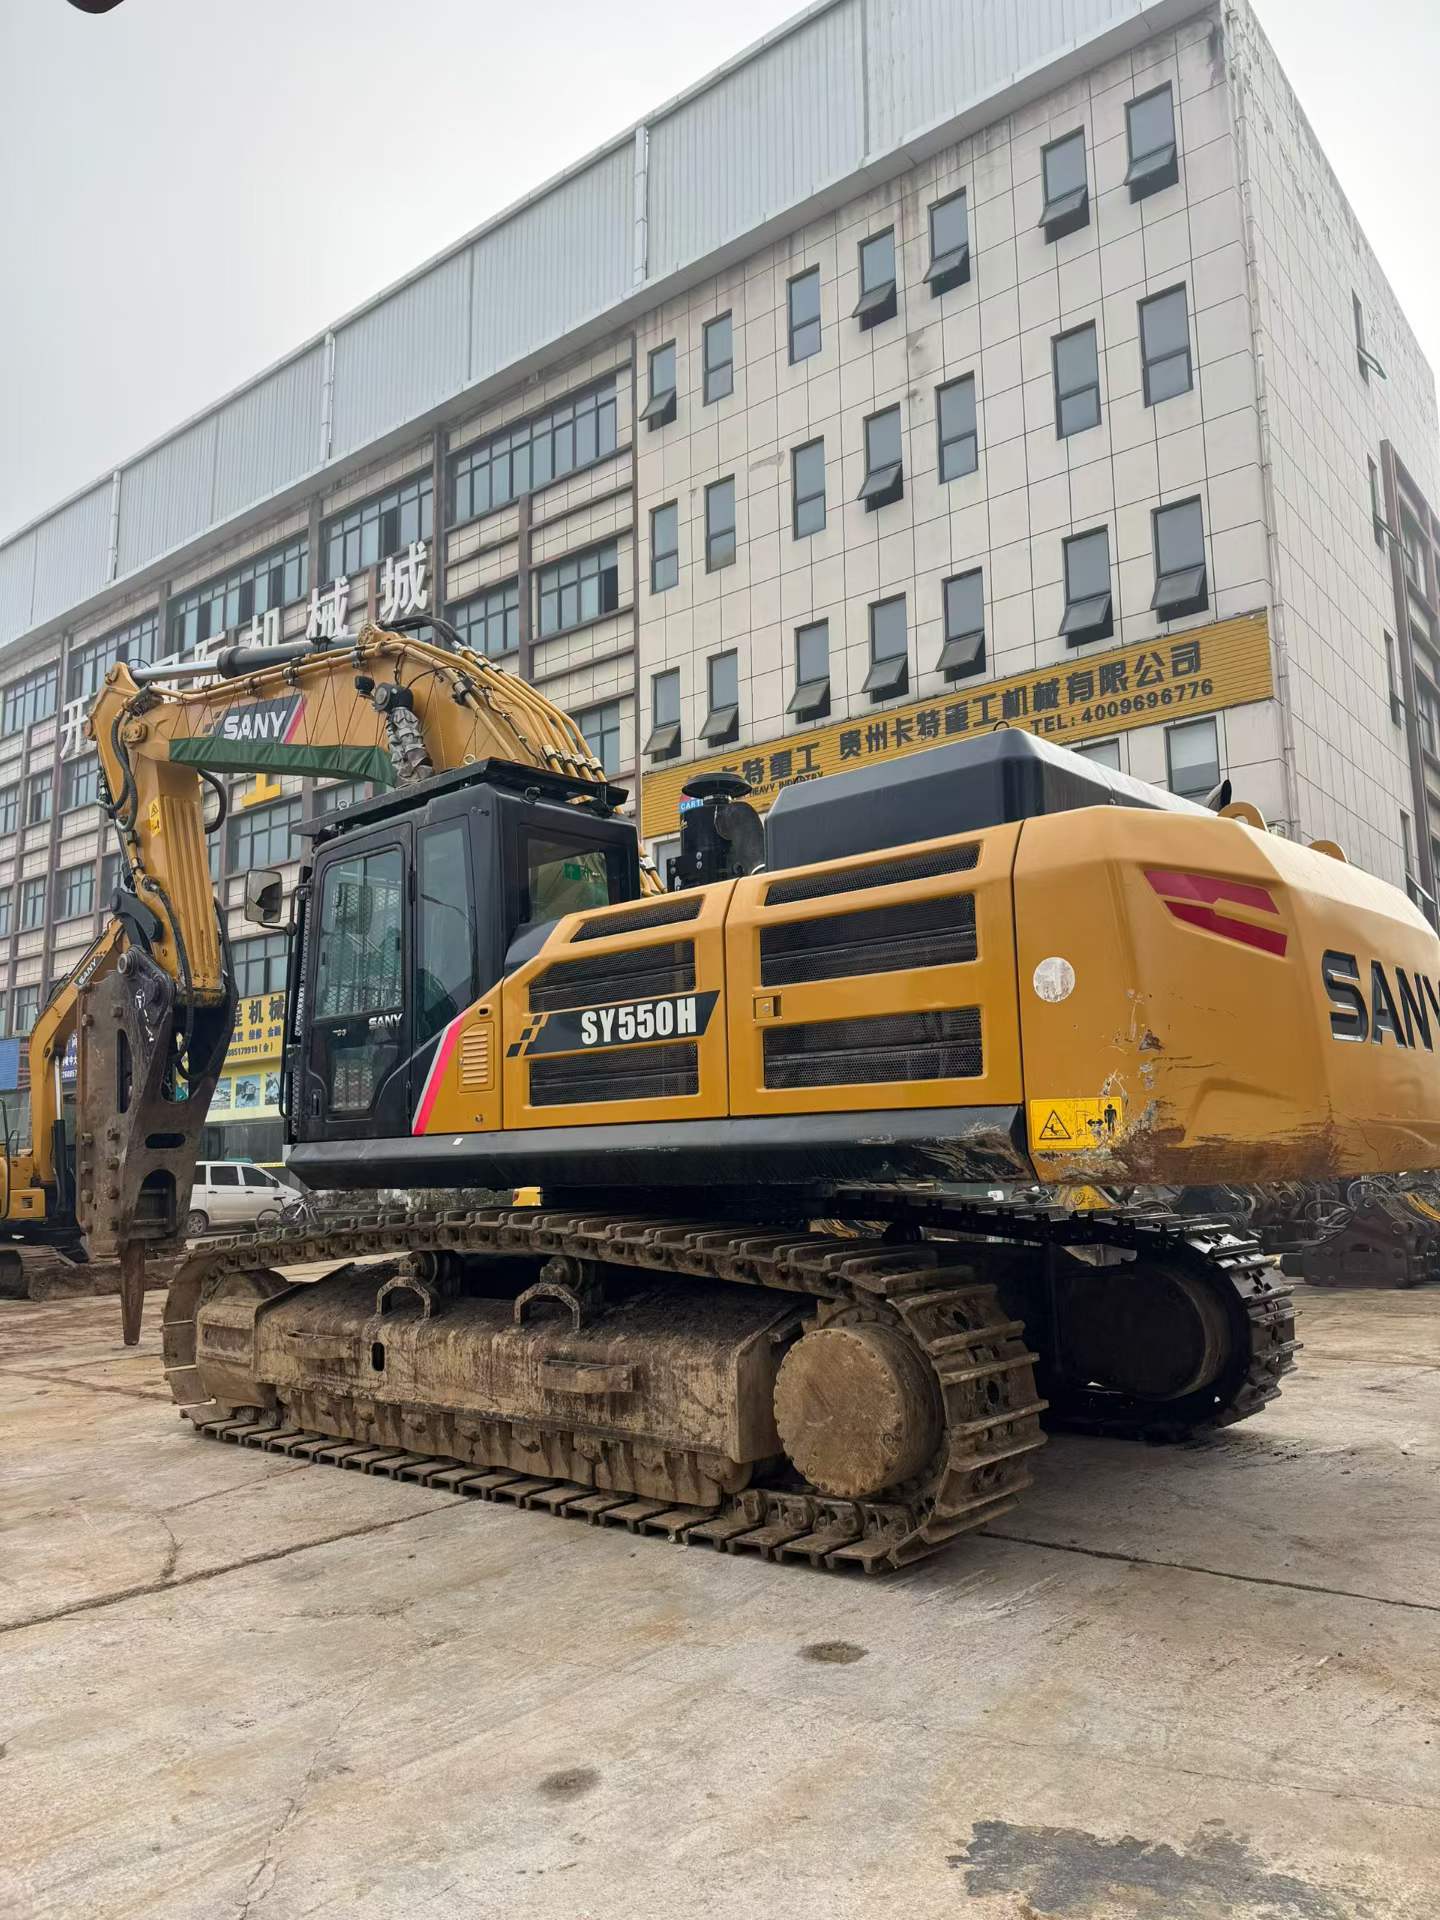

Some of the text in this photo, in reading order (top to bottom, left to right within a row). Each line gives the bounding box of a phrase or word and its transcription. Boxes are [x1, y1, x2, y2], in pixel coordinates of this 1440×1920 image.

[839, 640, 1201, 761] 贵州卡特重工机械有限公司
[223, 710, 287, 740] SANY
[78, 957, 96, 985] SANY
[368, 1013, 403, 1031] SANY
[581, 997, 697, 1045] SY550H
